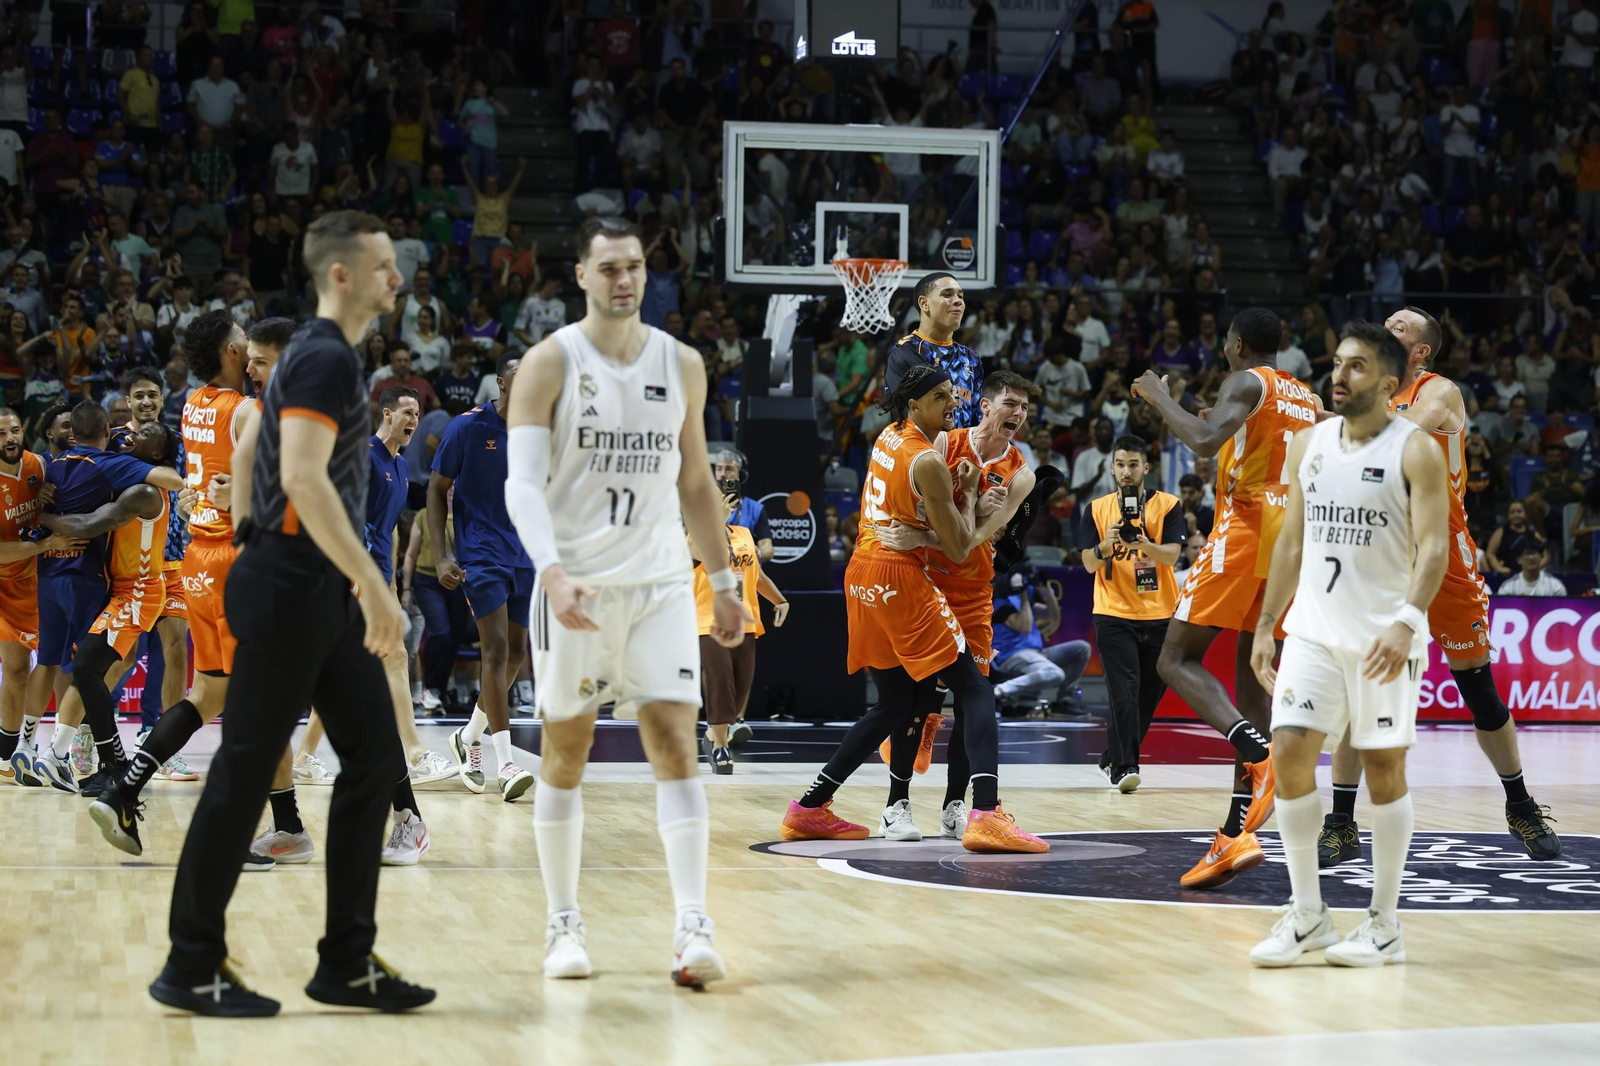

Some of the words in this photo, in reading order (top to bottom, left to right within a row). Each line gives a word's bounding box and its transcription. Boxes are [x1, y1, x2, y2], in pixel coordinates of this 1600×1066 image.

[832, 41, 876, 56] LOTUS
[1274, 378, 1314, 404] MOORE
[182, 402, 217, 426] PUERTO
[577, 426, 674, 451] Emirates
[878, 427, 904, 451] SAKO
[590, 453, 612, 473] FLY
[615, 454, 661, 474] BETTER
[189, 508, 219, 525] aldin
[768, 518, 810, 529] ercopa
[1306, 500, 1389, 527] Emirates
[1326, 526, 1372, 547] BETTER
[1325, 556, 1342, 593] 7
[850, 584, 876, 602] MGS
[1440, 633, 1475, 651] Midea
[971, 653, 989, 665] dea
[1507, 671, 1600, 710] MÁLA
